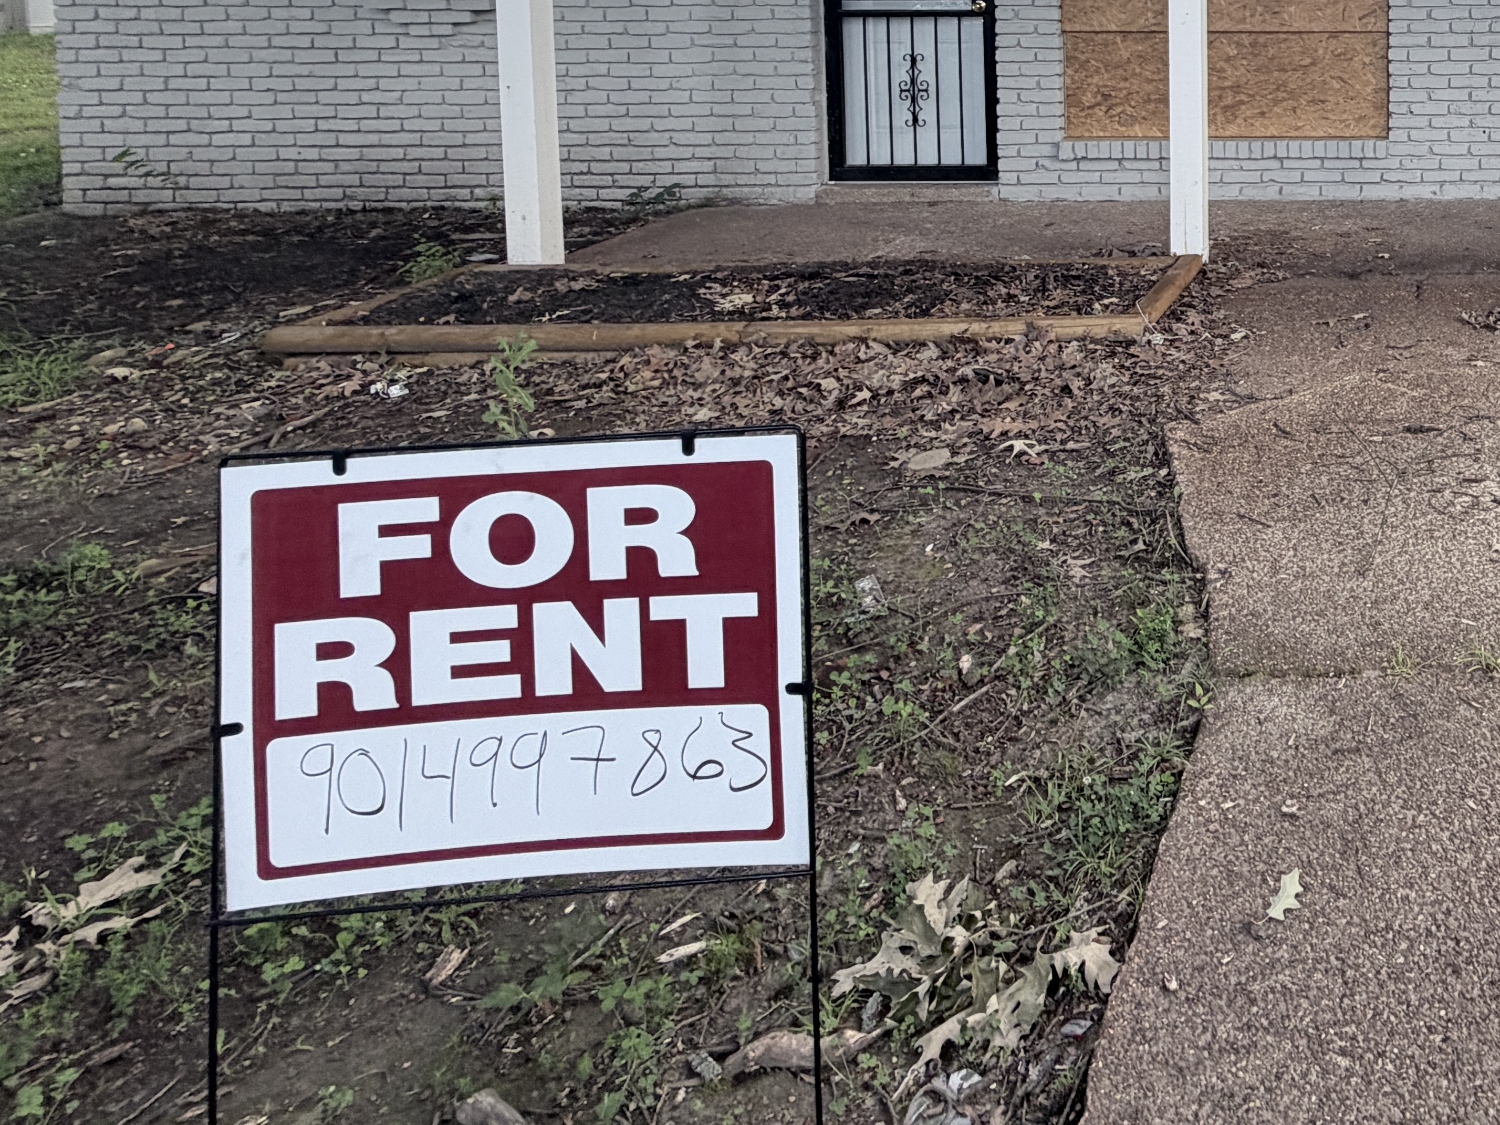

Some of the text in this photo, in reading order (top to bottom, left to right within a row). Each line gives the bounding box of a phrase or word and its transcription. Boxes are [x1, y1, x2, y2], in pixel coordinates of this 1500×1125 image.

[337, 483, 700, 600] FOR
[273, 591, 759, 721] RENT
[300, 711, 768, 835] 9014997863
